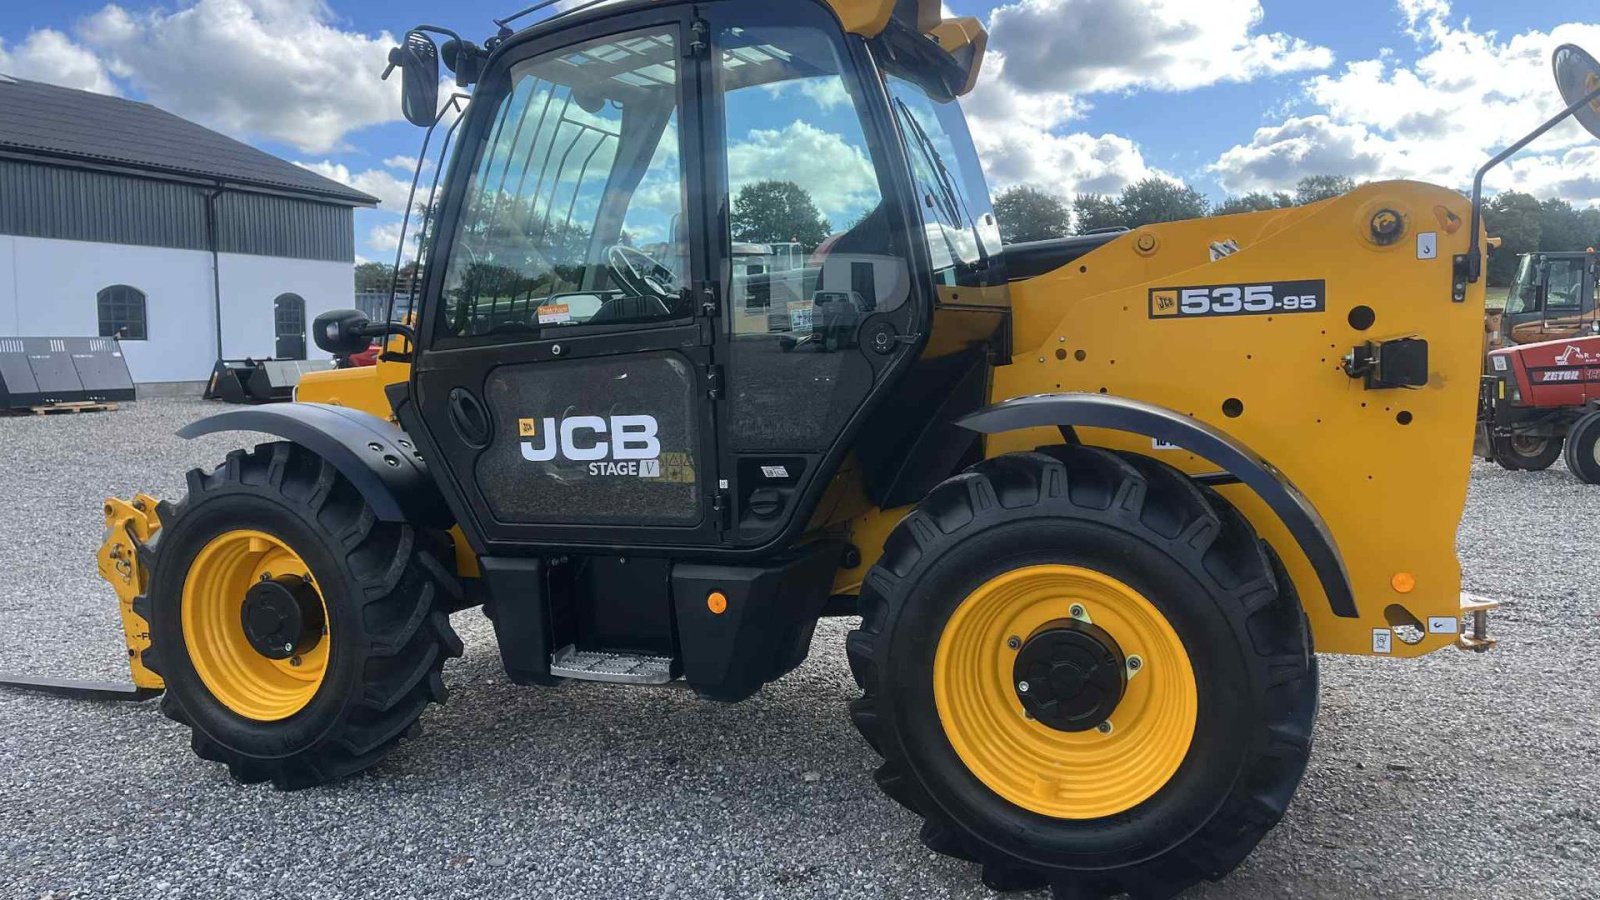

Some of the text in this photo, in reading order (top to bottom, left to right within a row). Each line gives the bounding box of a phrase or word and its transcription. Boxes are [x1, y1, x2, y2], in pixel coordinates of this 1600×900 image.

[1180, 285, 1317, 314] 535-95
[1543, 370, 1580, 381] ZETOR
[520, 414, 661, 462] JCB
[588, 461, 638, 476] STAGE
